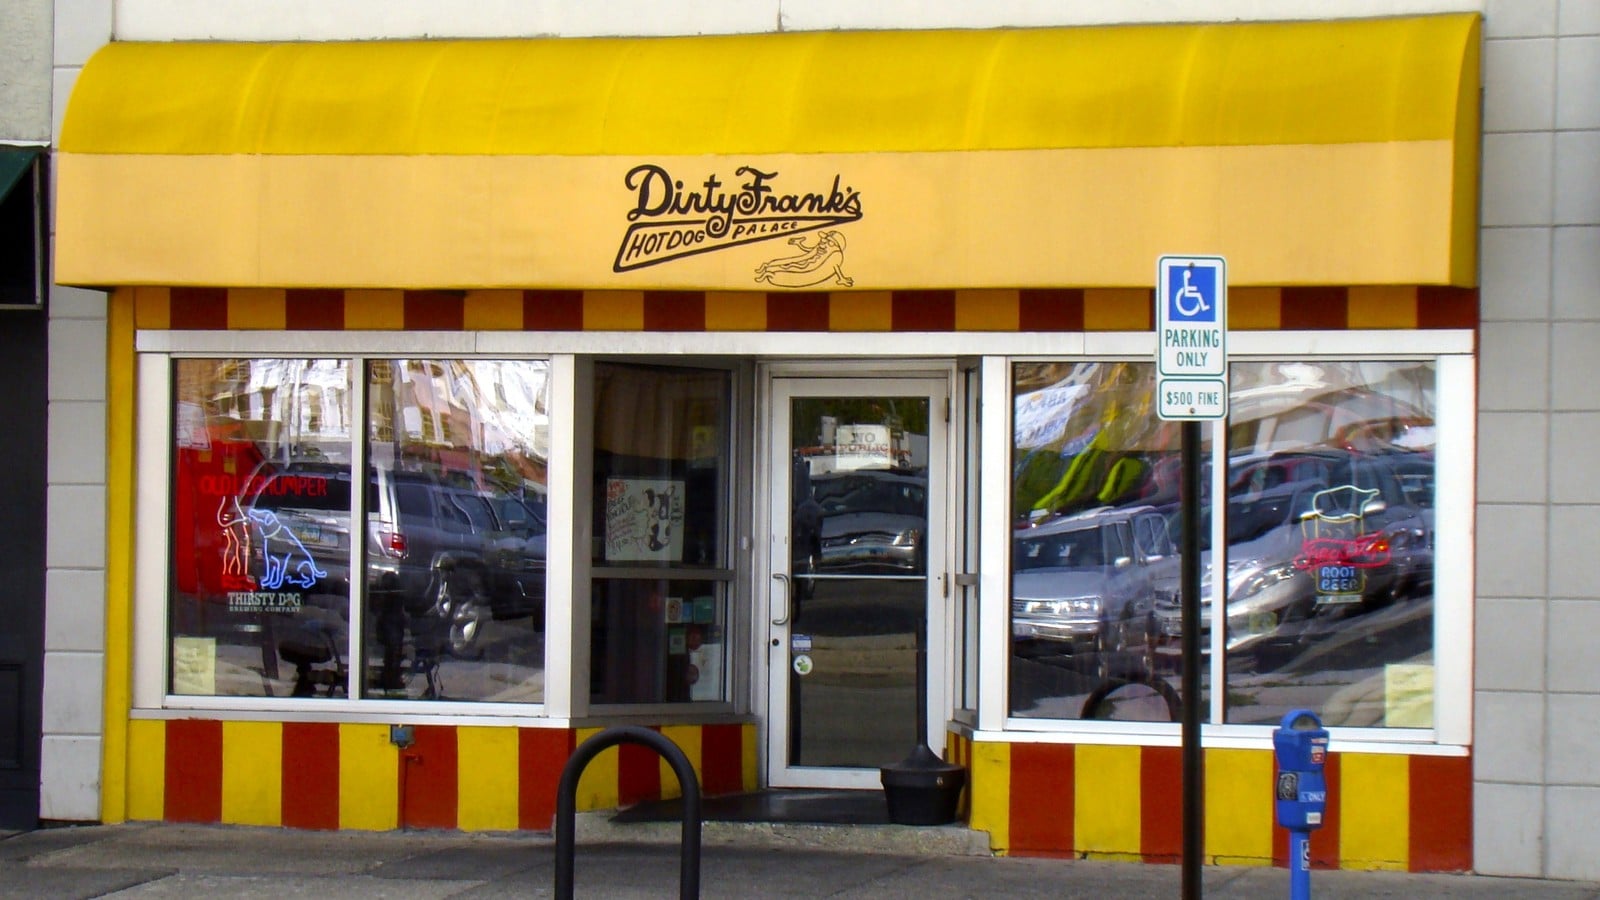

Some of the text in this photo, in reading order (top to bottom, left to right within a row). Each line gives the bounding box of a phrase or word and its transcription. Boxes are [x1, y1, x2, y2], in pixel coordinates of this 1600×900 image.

[624, 164, 862, 239] Dirty Frank's
[732, 221, 798, 239] PALACE
[1165, 329, 1219, 348] PARKING
[1176, 352, 1207, 367] ONLY
[1166, 392, 1218, 405] $500 FINE
[1321, 566, 1355, 578] ROOT
[1321, 579, 1358, 590] BEER
[227, 592, 300, 606] THIRSTY DOG
